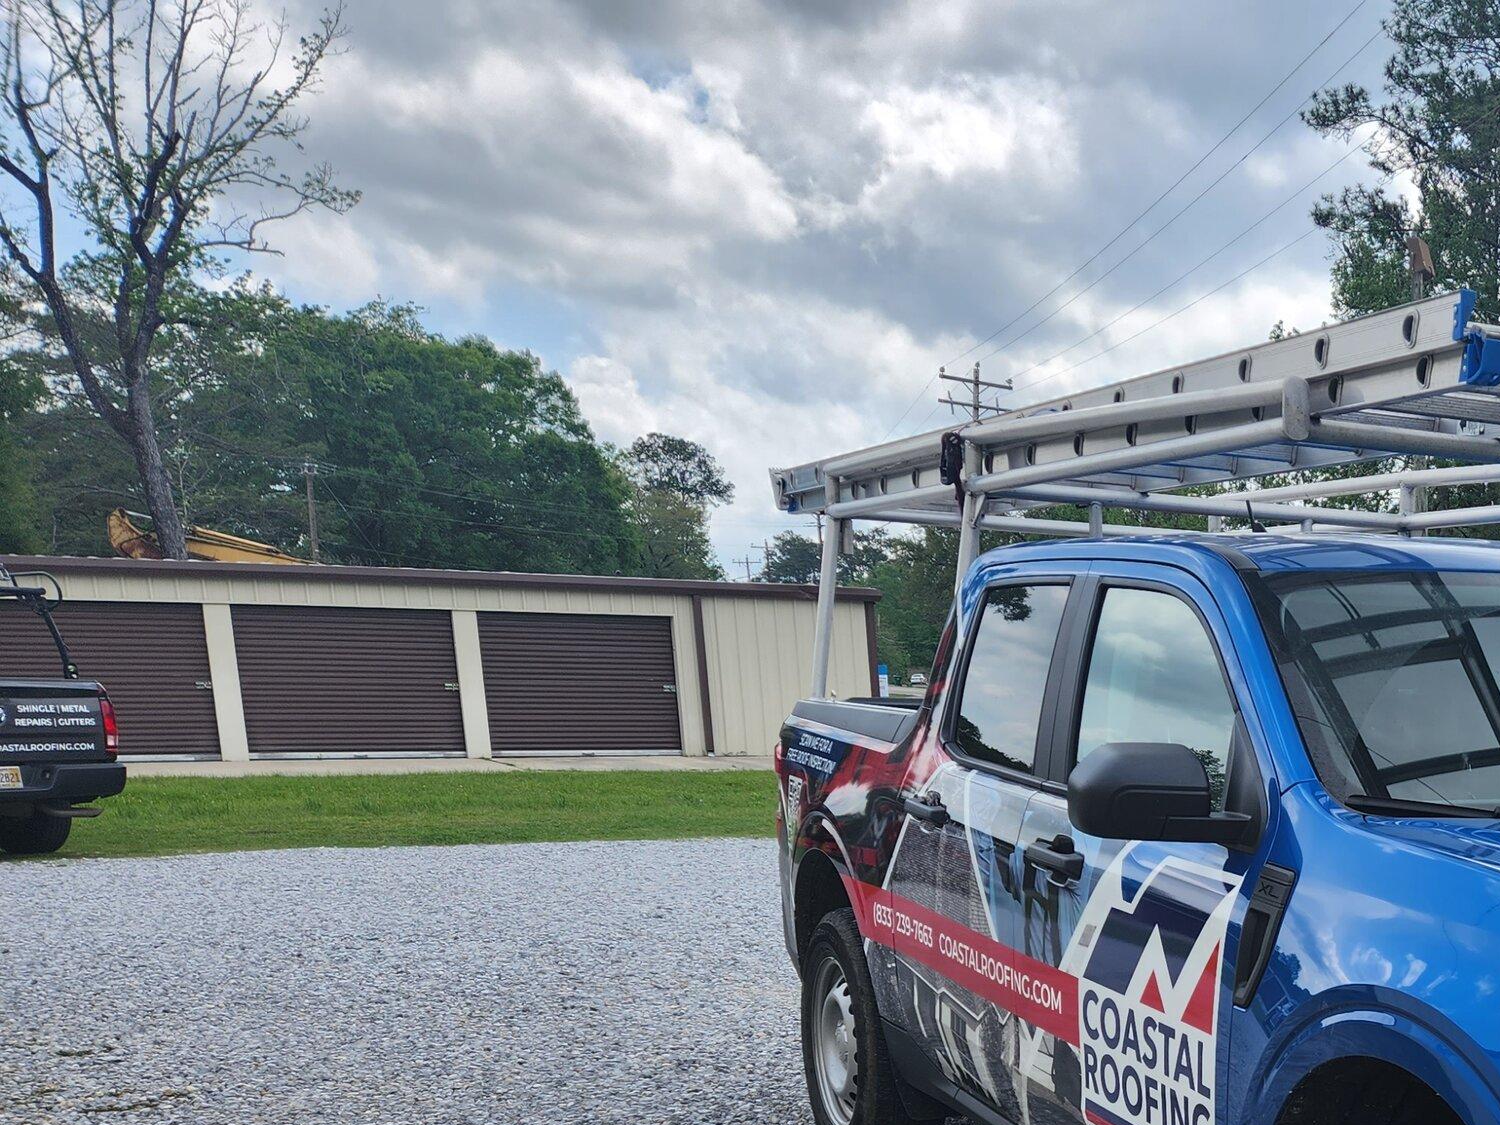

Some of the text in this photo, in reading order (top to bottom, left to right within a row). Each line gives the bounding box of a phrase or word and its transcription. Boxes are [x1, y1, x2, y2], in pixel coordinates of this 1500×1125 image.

[17, 704, 90, 713] SHINGLE METAL
[14, 717, 96, 727] REPAIRS GUTTERS
[1258, 880, 1279, 899] XL
[873, 901, 1063, 1015] (833) 239-7663 COASTALROOFING.COM
[1082, 989, 1211, 1099] COASTAL
